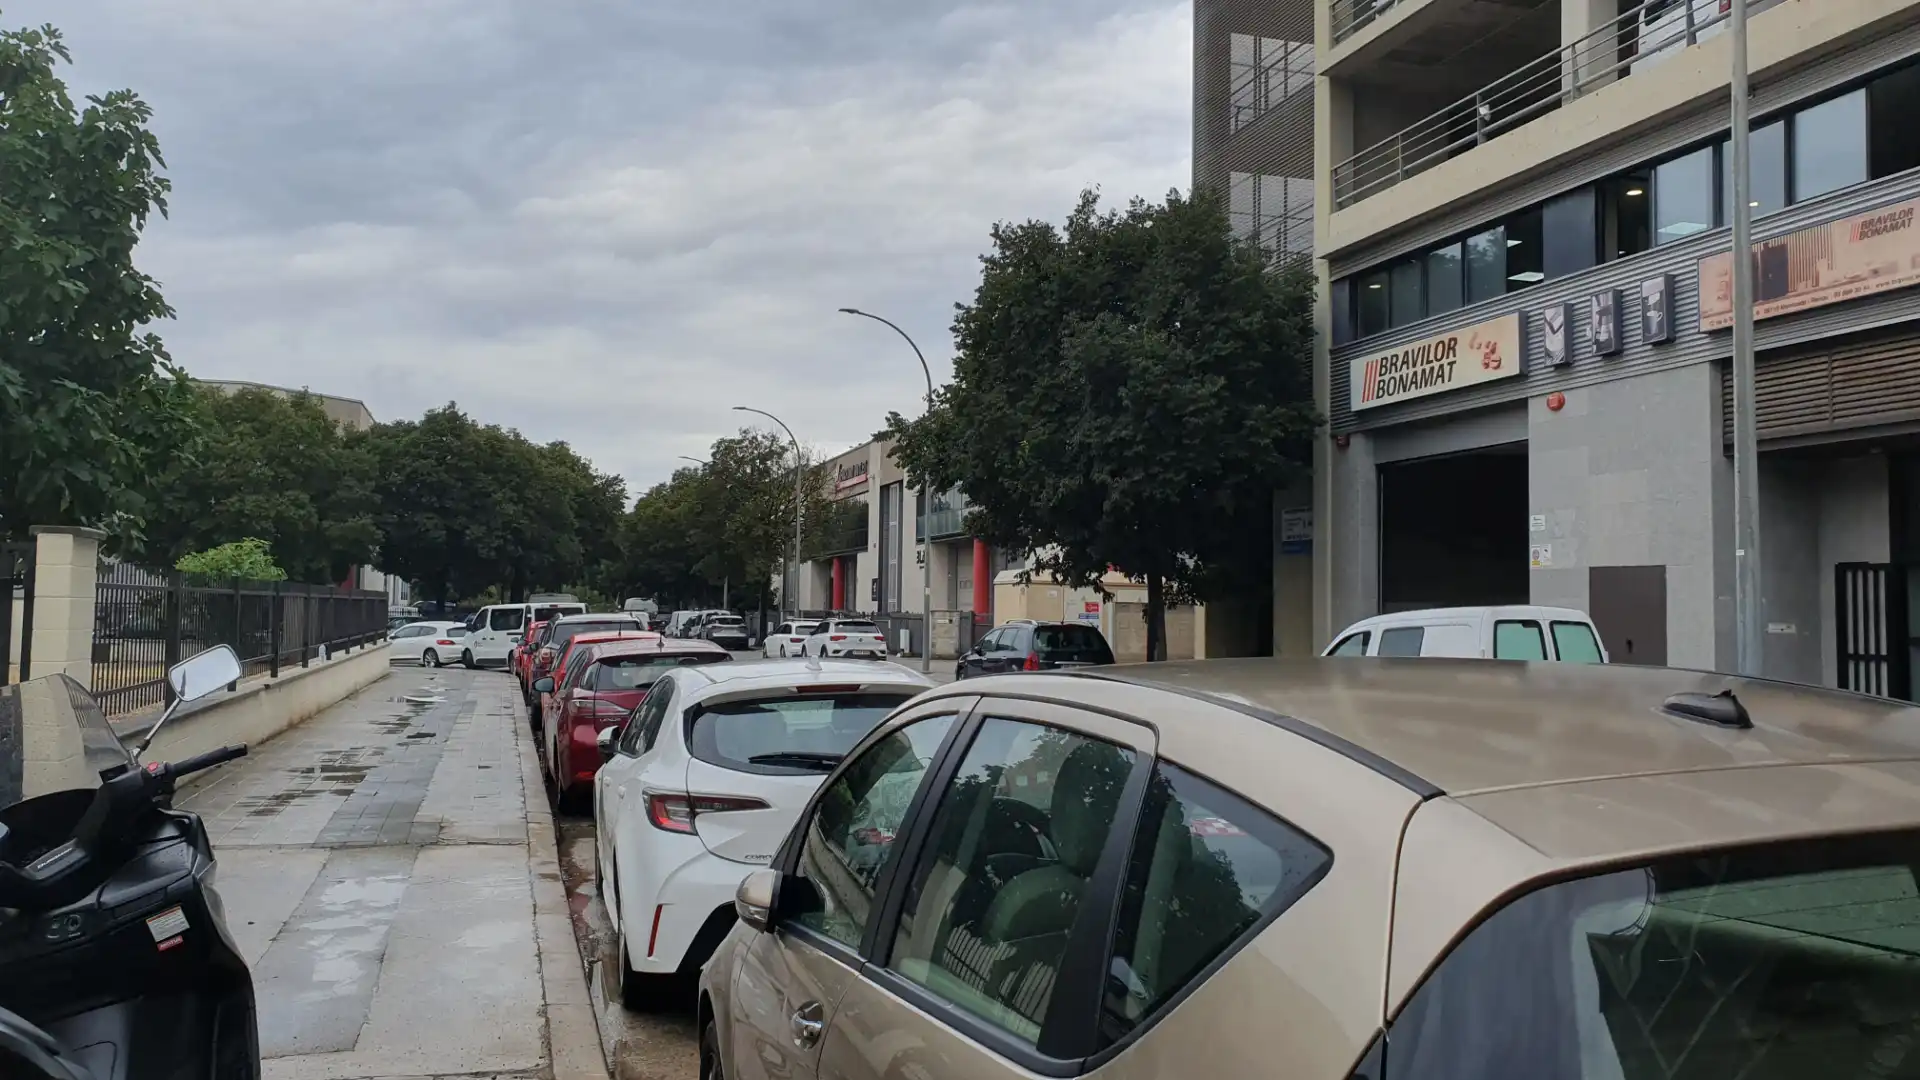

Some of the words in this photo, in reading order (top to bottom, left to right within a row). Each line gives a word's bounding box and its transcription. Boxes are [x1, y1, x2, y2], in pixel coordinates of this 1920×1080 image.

[1859, 217, 1914, 241] BONAMAT
[1860, 207, 1914, 230] BRAVILOR
[1378, 337, 1459, 378] BRAVILOR
[1376, 360, 1457, 399] BONAMAT
